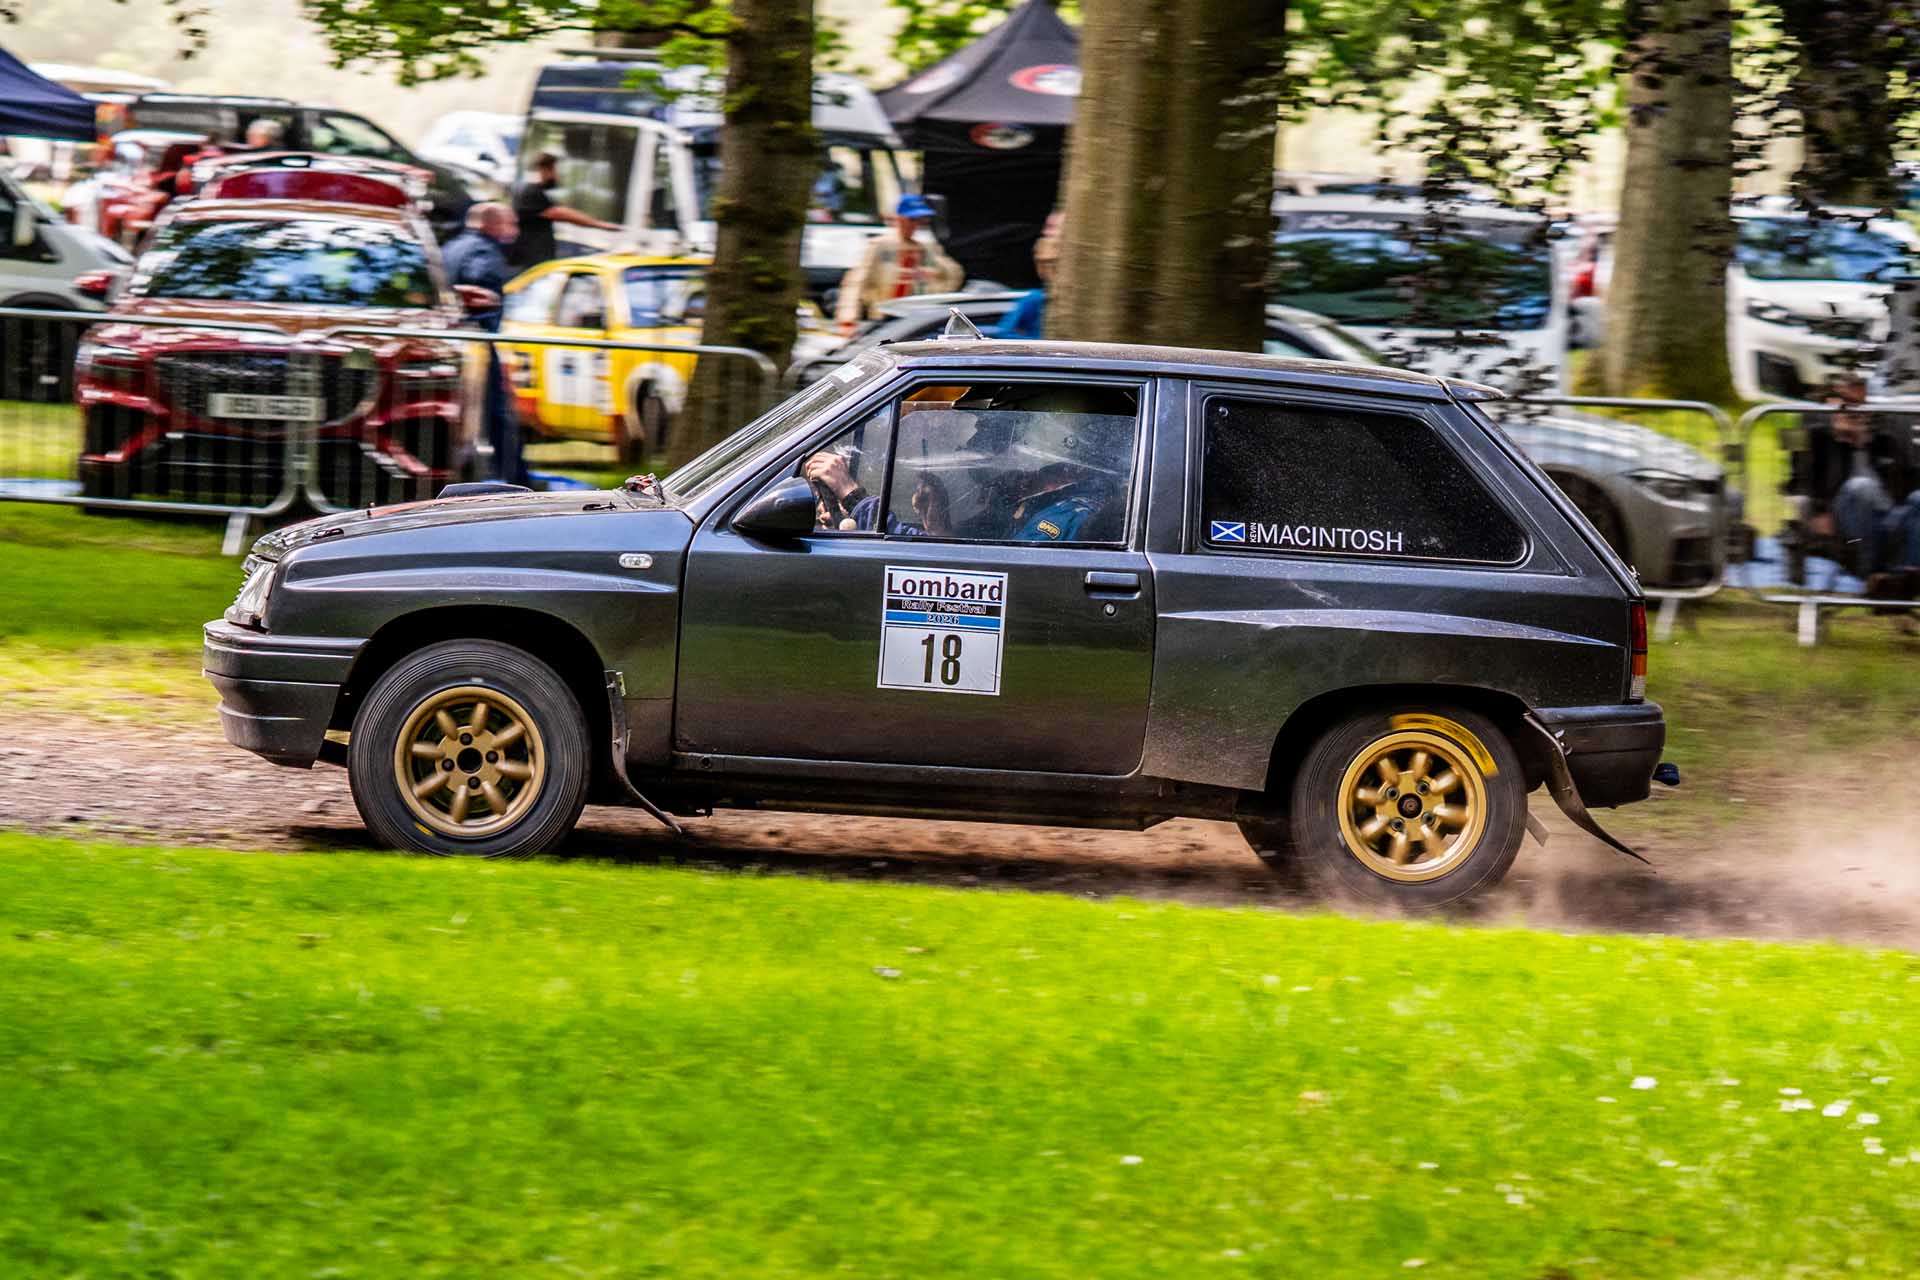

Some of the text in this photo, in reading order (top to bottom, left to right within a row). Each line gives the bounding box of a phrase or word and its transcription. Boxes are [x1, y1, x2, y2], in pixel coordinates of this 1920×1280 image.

[1257, 523, 1403, 552] MACINTOSH
[887, 573, 1004, 601] Lombard
[901, 599, 987, 614] Rally Festival
[928, 614, 960, 624] 2026
[921, 633, 962, 686] 18
